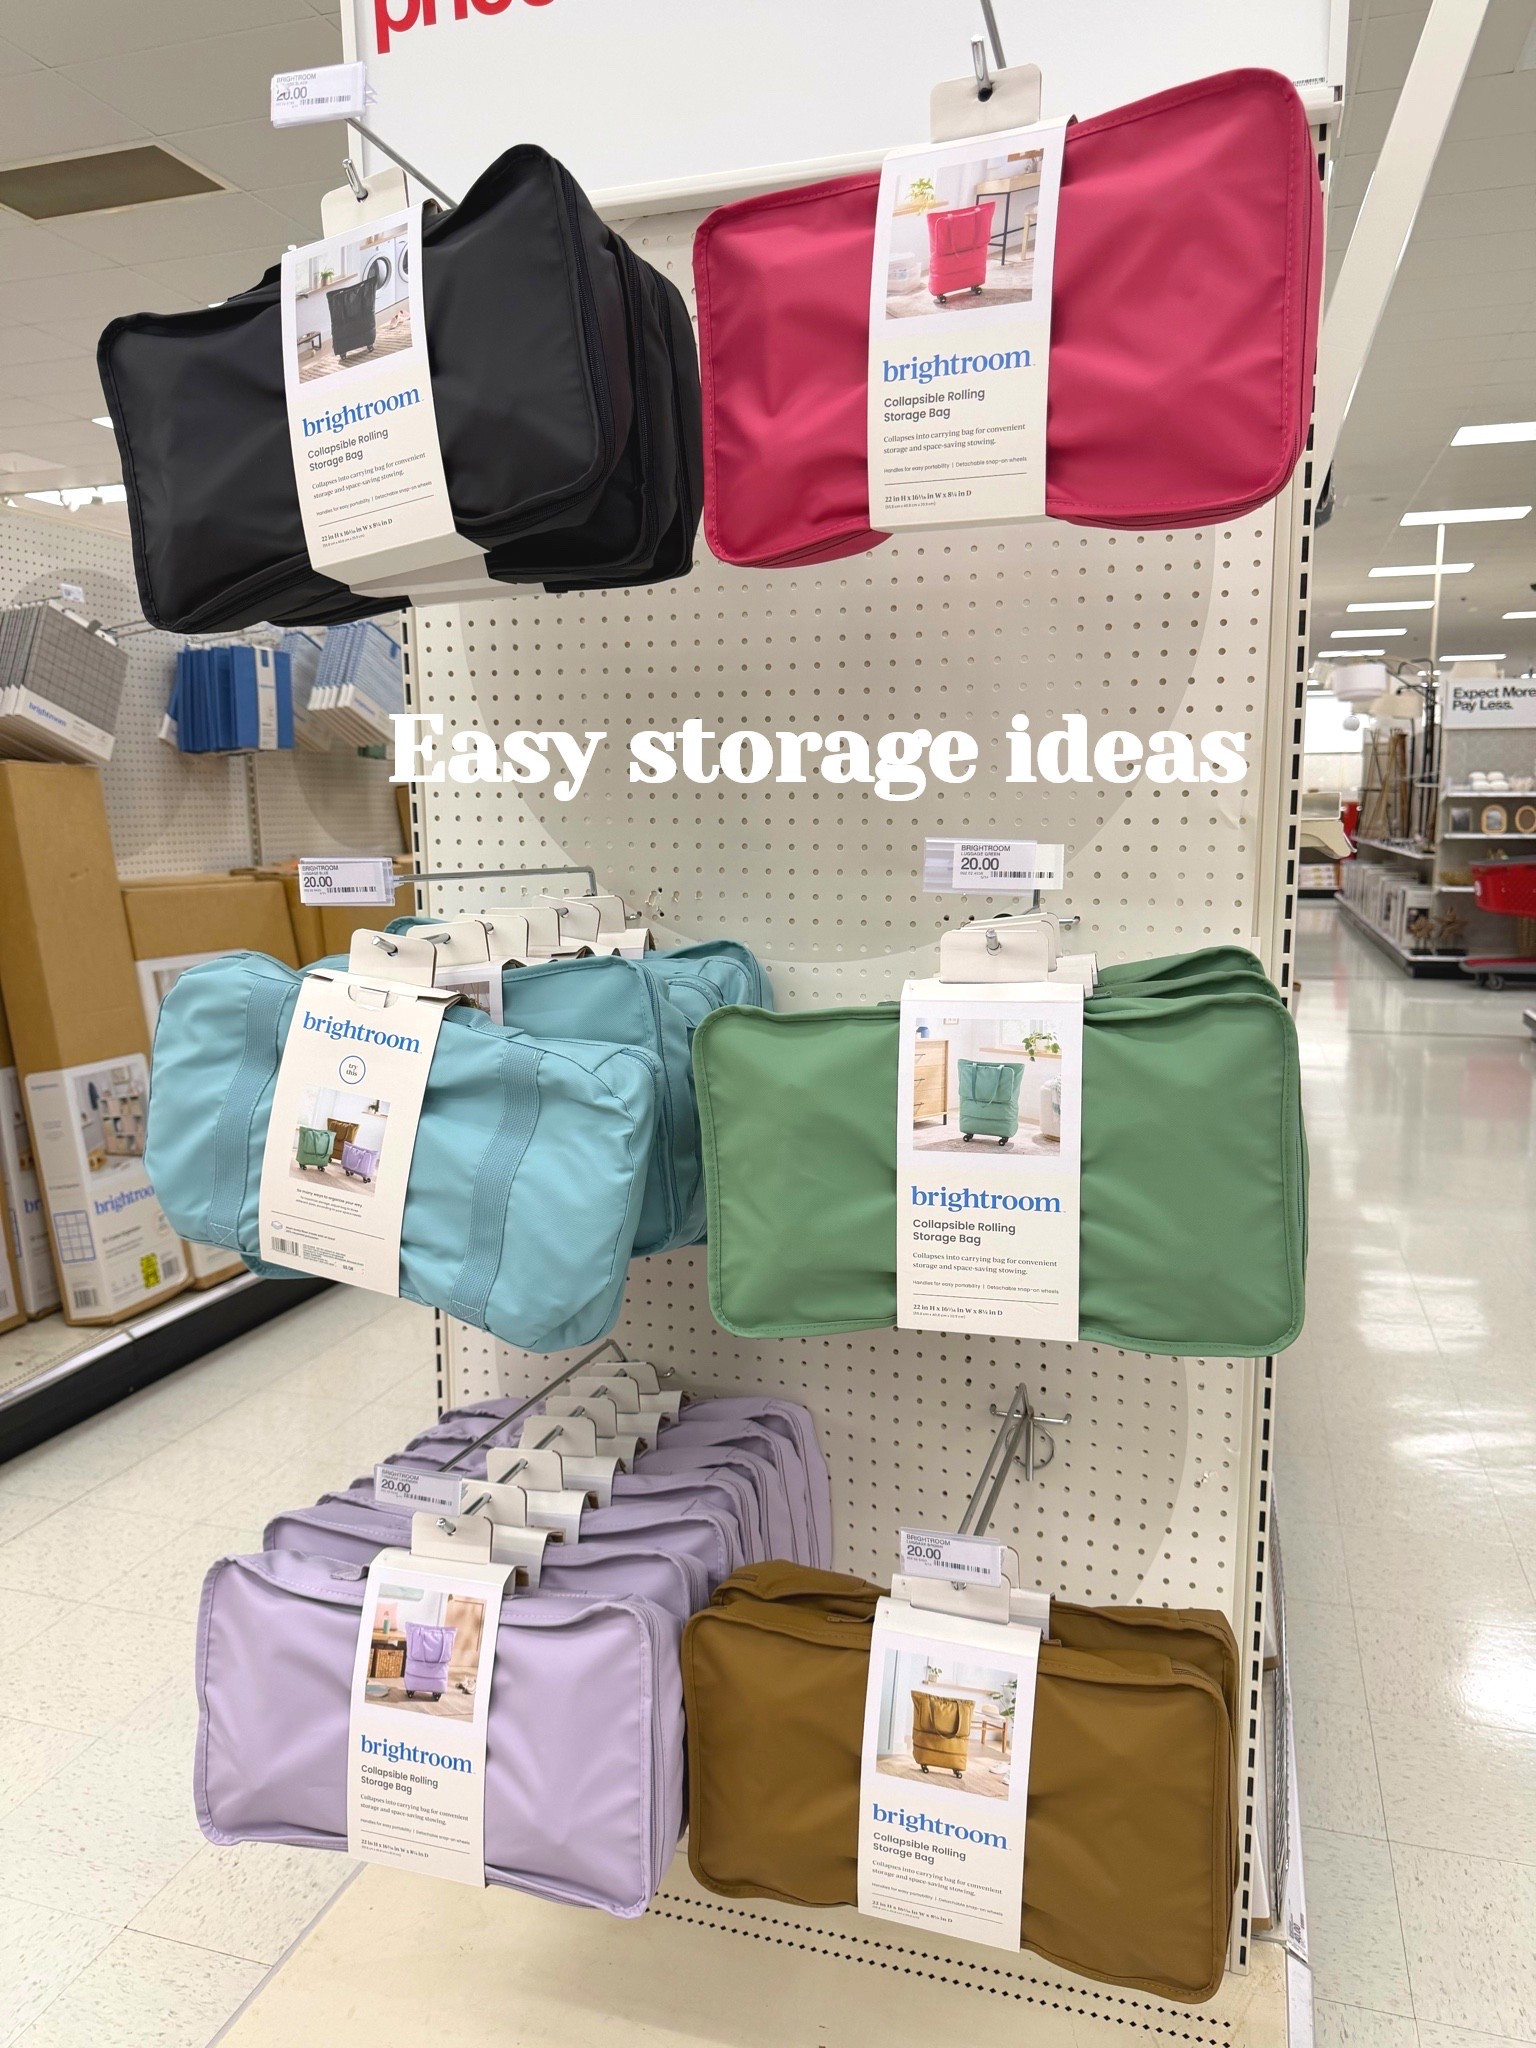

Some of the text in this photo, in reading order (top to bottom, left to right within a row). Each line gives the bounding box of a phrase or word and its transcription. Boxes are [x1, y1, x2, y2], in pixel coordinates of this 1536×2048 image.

[883, 350, 1031, 384] brightroom
[884, 389, 985, 408] Collapsible Rolling
[302, 388, 420, 437] brightroom
[884, 408, 950, 422] Storage Bag
[884, 434, 914, 442] Collapses
[931, 430, 960, 439] carrying
[962, 428, 974, 436] bag
[987, 424, 1025, 434] convenient
[308, 429, 388, 458] Collapsible Rolling
[884, 446, 908, 454] storage
[923, 440, 966, 451] space-saving
[967, 437, 996, 446] stowing.
[310, 450, 363, 471] Storage Bag
[956, 459, 984, 467] Detachable
[312, 479, 337, 490] Collapses
[350, 469, 374, 480] carrying
[395, 452, 426, 466] convenient
[314, 469, 404, 499] storage and space-saving stowing.
[1453, 687, 1499, 699] Expect
[1453, 700, 1513, 713] Pay Less.
[960, 857, 999, 870] 20.00
[304, 876, 332, 888] 20.00
[303, 1011, 420, 1053] brightroom
[94, 1185, 155, 1216] brightroo
[911, 1186, 1061, 1212] brightroom
[913, 1219, 1016, 1235] Collapsible Rolling
[913, 1232, 981, 1246] Storage Bag
[913, 1252, 944, 1261] Collapses
[946, 1253, 960, 1261] into
[961, 1255, 991, 1263] carrying
[993, 1256, 1006, 1264] bag
[1018, 1259, 1057, 1267] convenient
[913, 1262, 938, 1270] storage
[953, 1264, 997, 1274] space-saving
[999, 1267, 1028, 1275] stowing.
[382, 1470, 420, 1480] BRIGHTROOM
[382, 1479, 410, 1493] 20.00
[907, 1534, 950, 1545] BRIGHTROOM
[907, 1545, 941, 1560] 20.00
[361, 1735, 472, 1773] brightroom
[361, 1765, 438, 1789] Collapsible Rolling
[361, 1776, 412, 1795] Storage Bag
[361, 1794, 384, 1804] Collapses
[397, 1802, 419, 1812] carrying
[420, 1805, 430, 1814] bag
[439, 1811, 468, 1821] convenient
[361, 1803, 379, 1811] storage
[391, 1809, 424, 1821] space-saving
[425, 1816, 446, 1826] stowing.
[873, 1803, 1007, 1850] brightroom
[873, 1832, 966, 1862] Collapsible Rolling
[873, 1843, 935, 1865] Storage Bag
[872, 1868, 976, 1896] storage and space-saving stowing.
[873, 1860, 1002, 1895] Collapses into carrying bag for convenient
